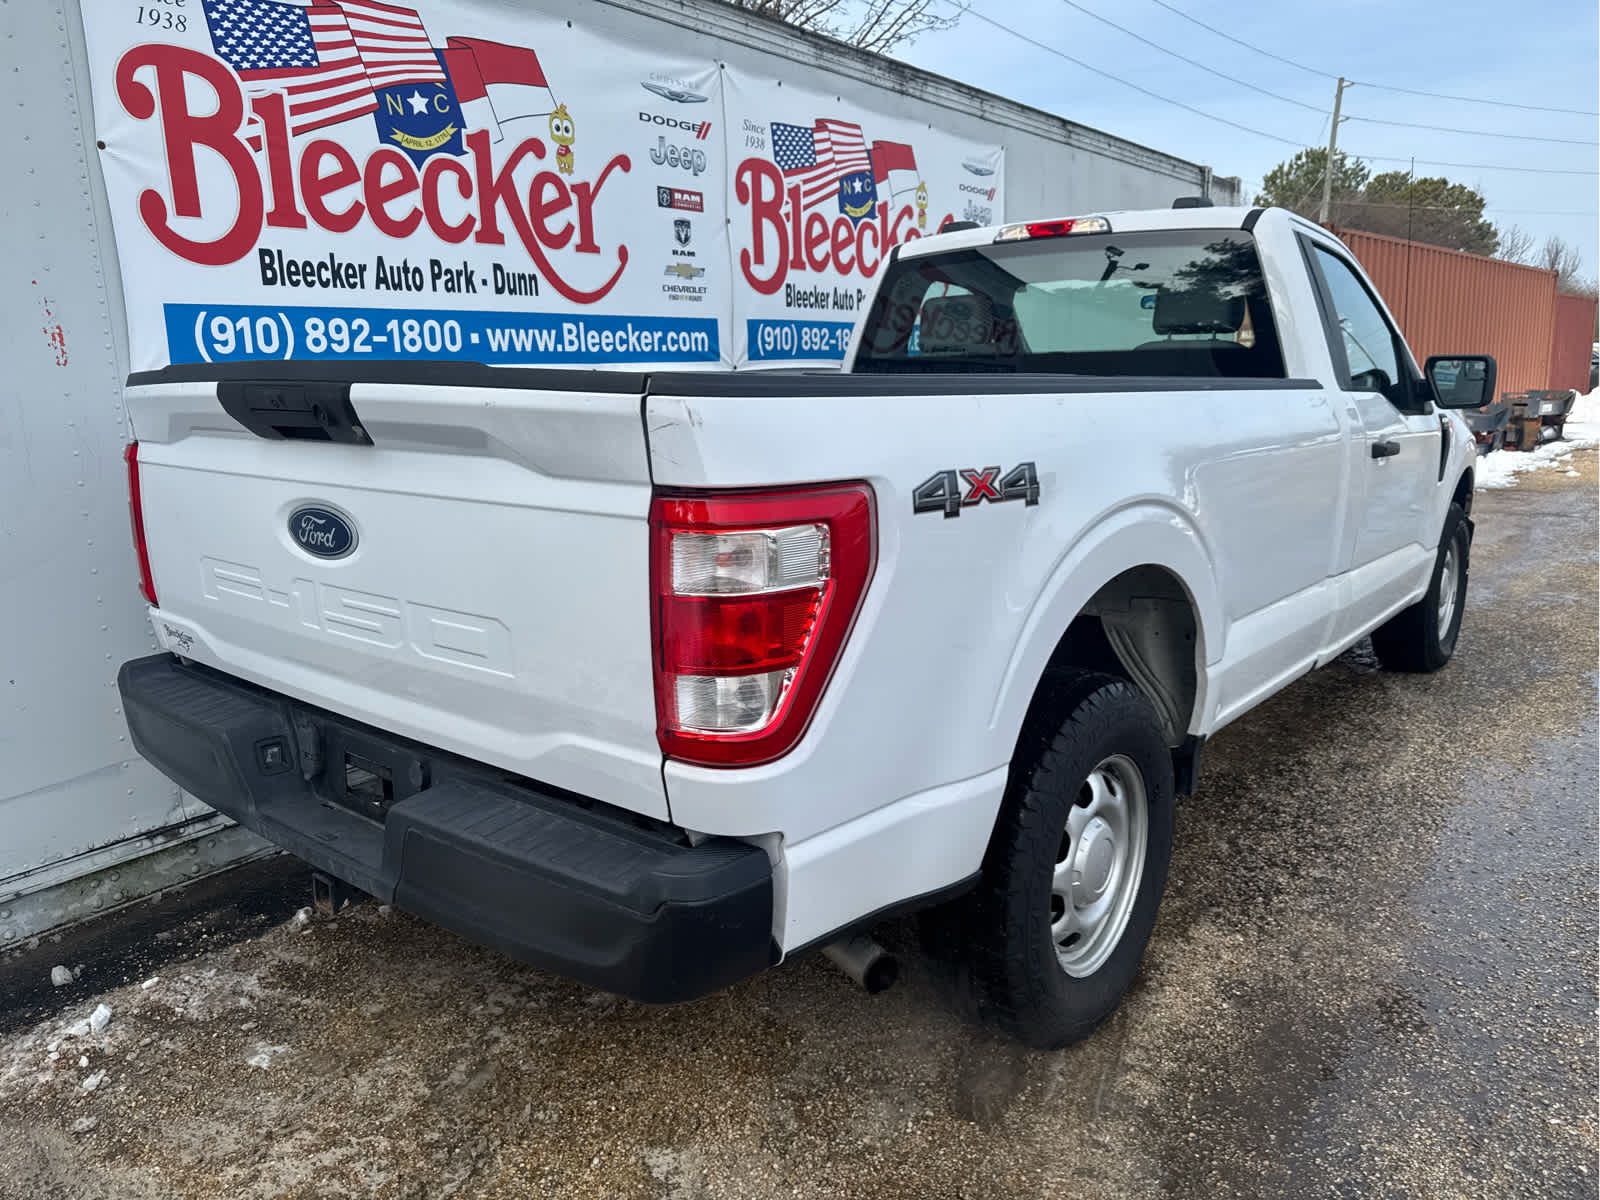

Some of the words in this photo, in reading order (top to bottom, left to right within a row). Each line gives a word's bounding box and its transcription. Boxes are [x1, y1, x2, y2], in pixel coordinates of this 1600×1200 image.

[135, 6, 187, 33] 1938
[385, 93, 404, 116] N
[433, 93, 450, 113] C
[639, 112, 702, 133] DODGE
[649, 136, 706, 177] Jeep
[115, 43, 632, 304] Bleecker
[673, 192, 701, 204] RAM
[735, 157, 955, 295] Bleeck
[672, 248, 696, 257] RAM
[258, 248, 367, 289] Bleecker
[375, 255, 424, 292] Auto
[430, 258, 477, 294] Park
[492, 262, 539, 297] Dunn
[662, 284, 707, 294] CHEVROLET
[785, 282, 830, 309] Bleecker
[832, 287, 854, 311] Auto
[194, 311, 295, 362] (910)
[304, 317, 462, 353] 892-1800
[486, 322, 709, 352] www.Bleecker.com
[757, 323, 798, 356] (910)
[801, 326, 851, 352] 892-18
[299, 515, 337, 548] Ford
[200, 553, 516, 680] F-150
